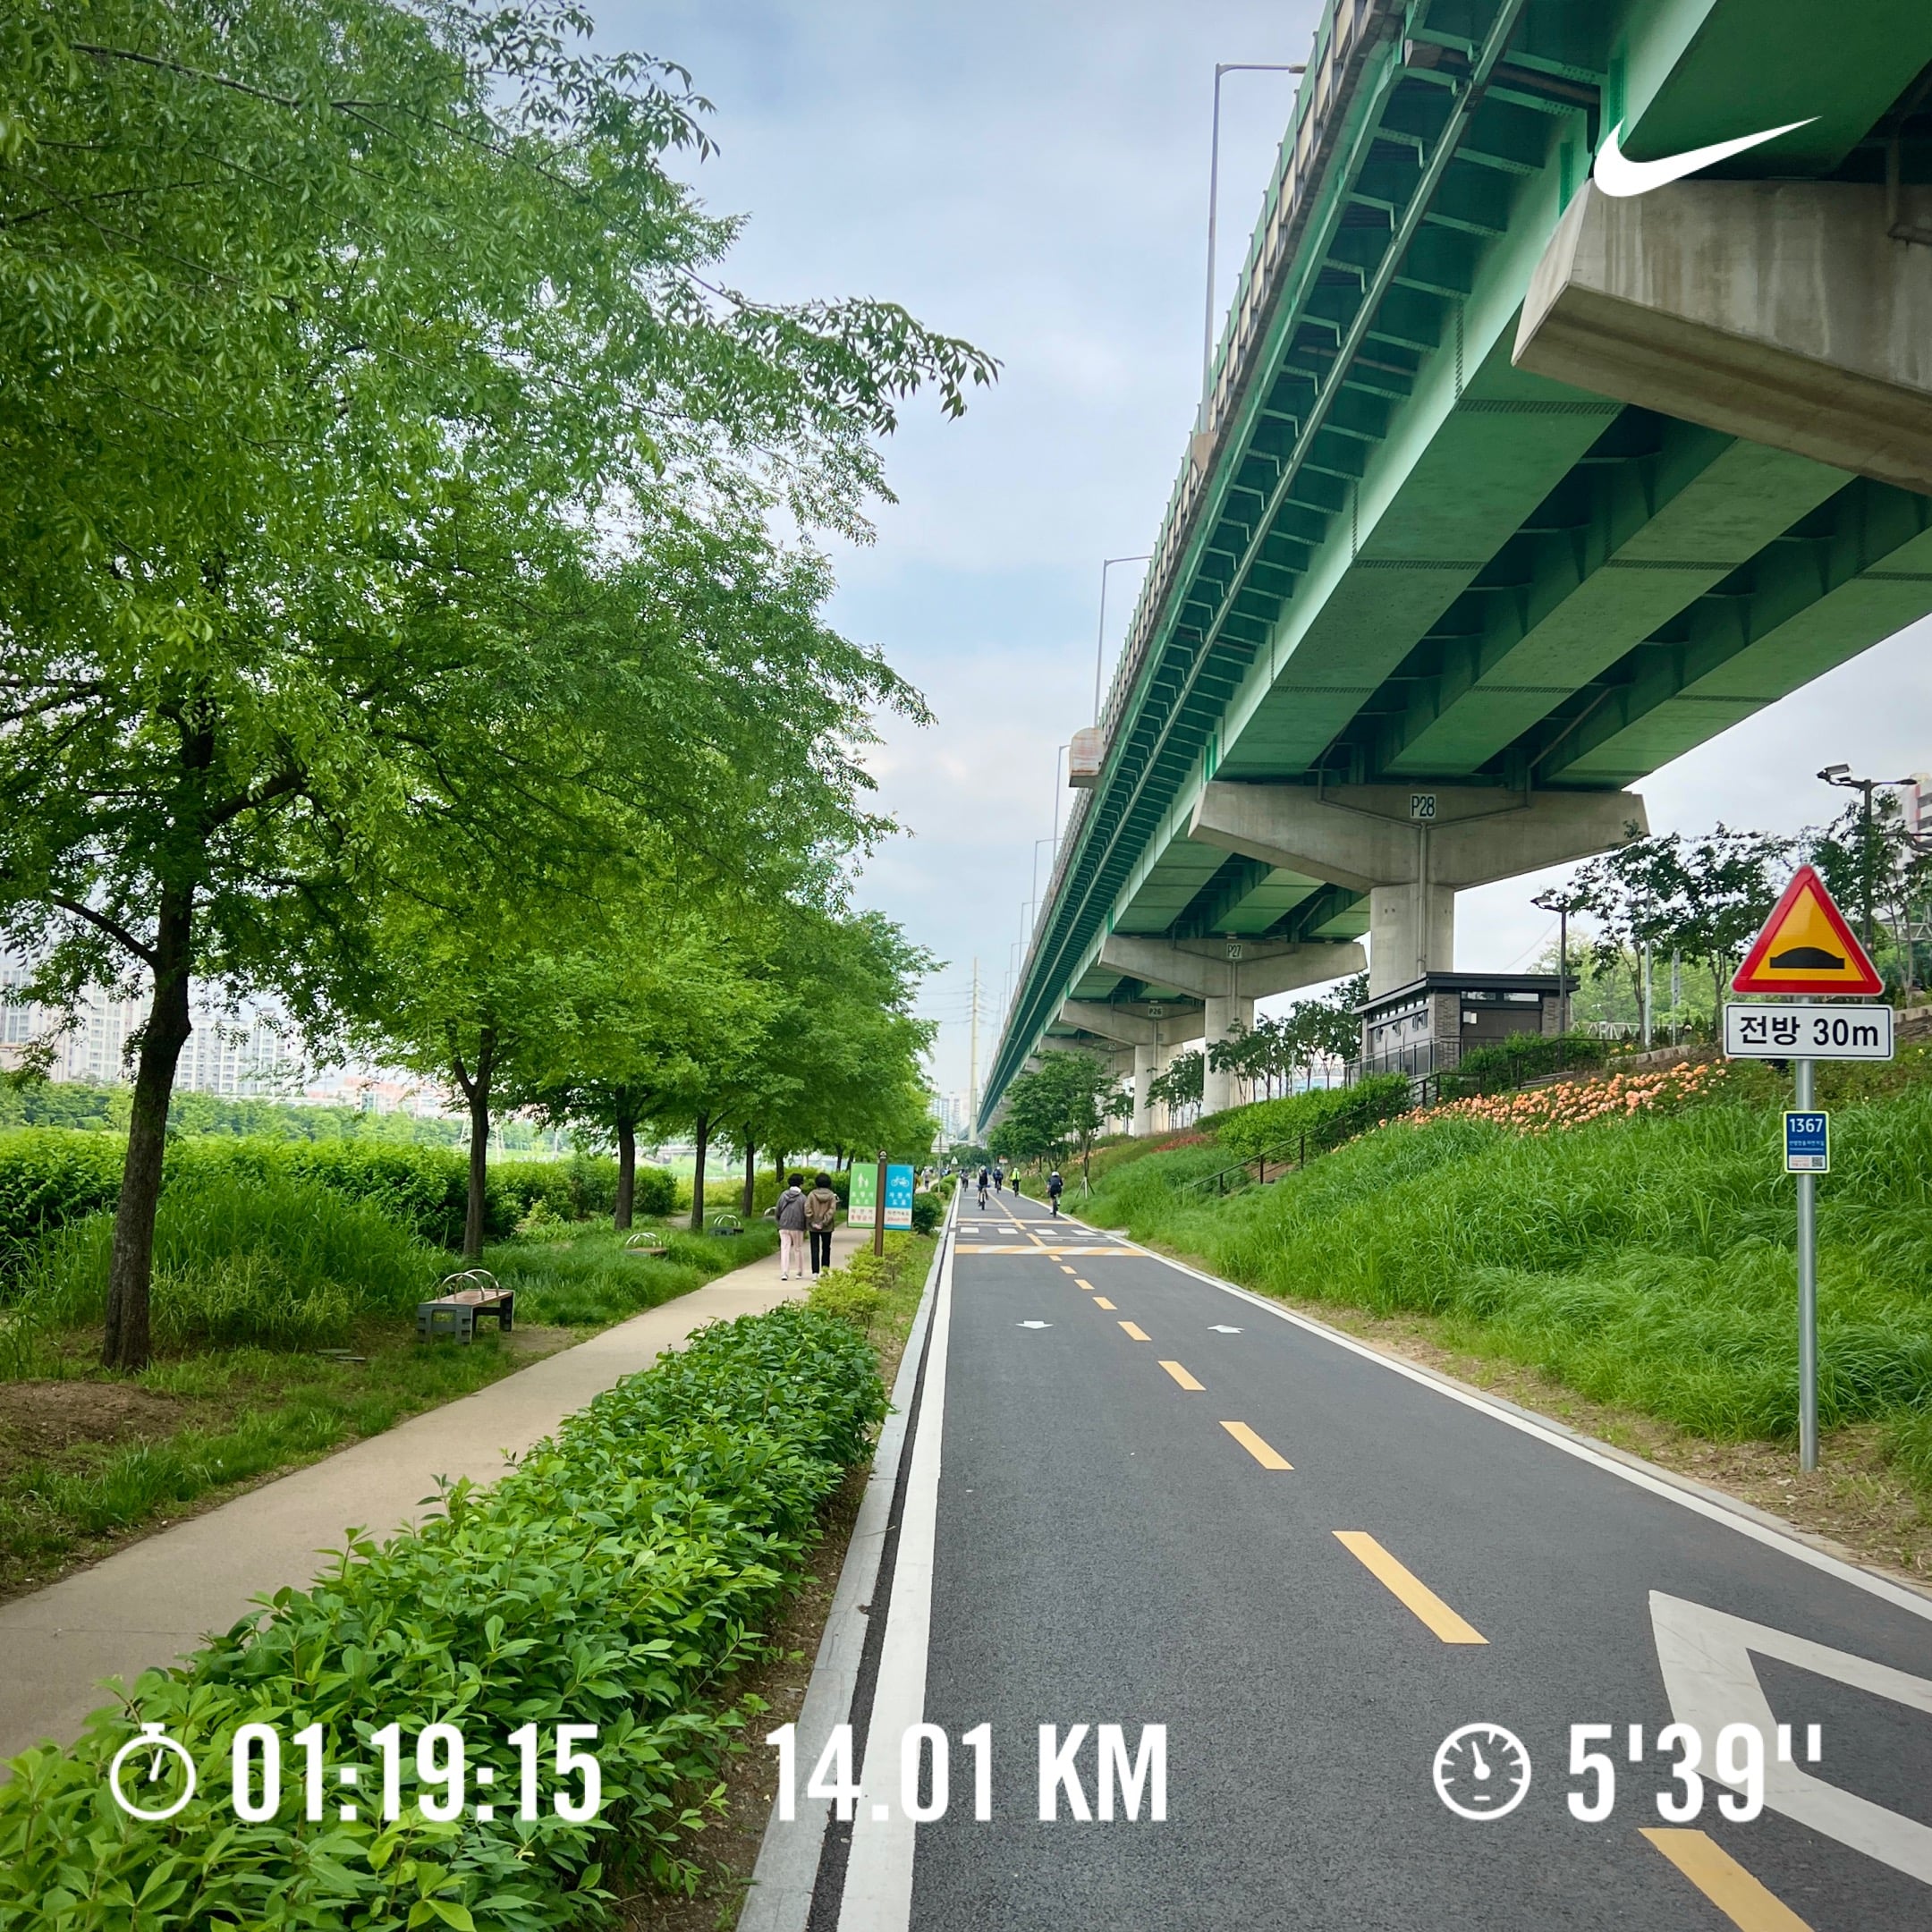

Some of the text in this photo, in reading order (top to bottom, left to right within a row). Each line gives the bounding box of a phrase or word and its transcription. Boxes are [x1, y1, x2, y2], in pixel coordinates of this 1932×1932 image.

[1411, 795, 1436, 818] P28
[1227, 944, 1241, 958] P27
[1739, 1015, 1878, 1046] 전방 30m
[1789, 1118, 1824, 1133] 1367
